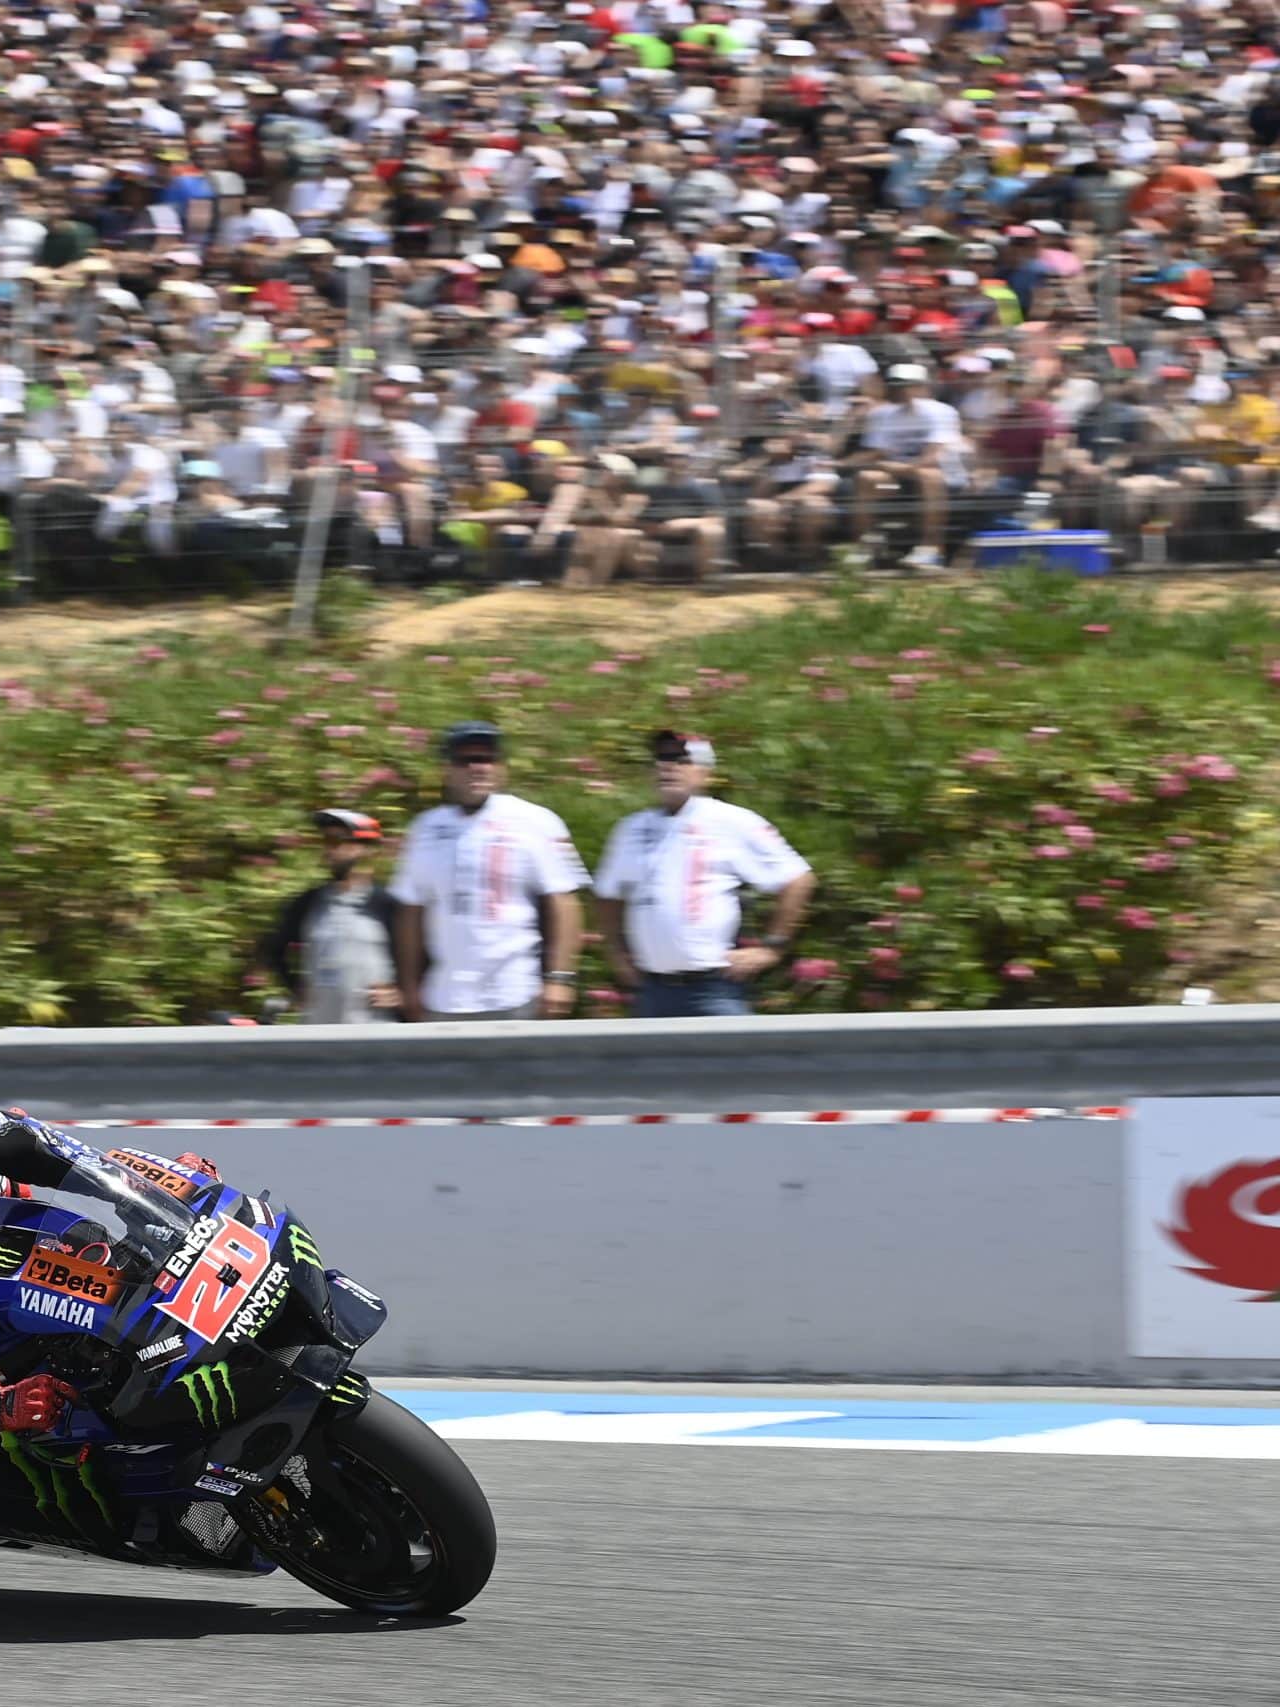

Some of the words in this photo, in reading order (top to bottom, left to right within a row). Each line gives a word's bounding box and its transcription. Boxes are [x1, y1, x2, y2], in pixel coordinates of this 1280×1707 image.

[165, 1214, 218, 1278] ENEOS
[48, 1263, 108, 1299] Beta
[152, 1211, 271, 1344] 20
[225, 1262, 290, 1343] MONSTER
[20, 1286, 96, 1329] YAMAHA
[247, 1280, 290, 1338] ENERGY
[136, 1334, 184, 1362] YAMALUBE
